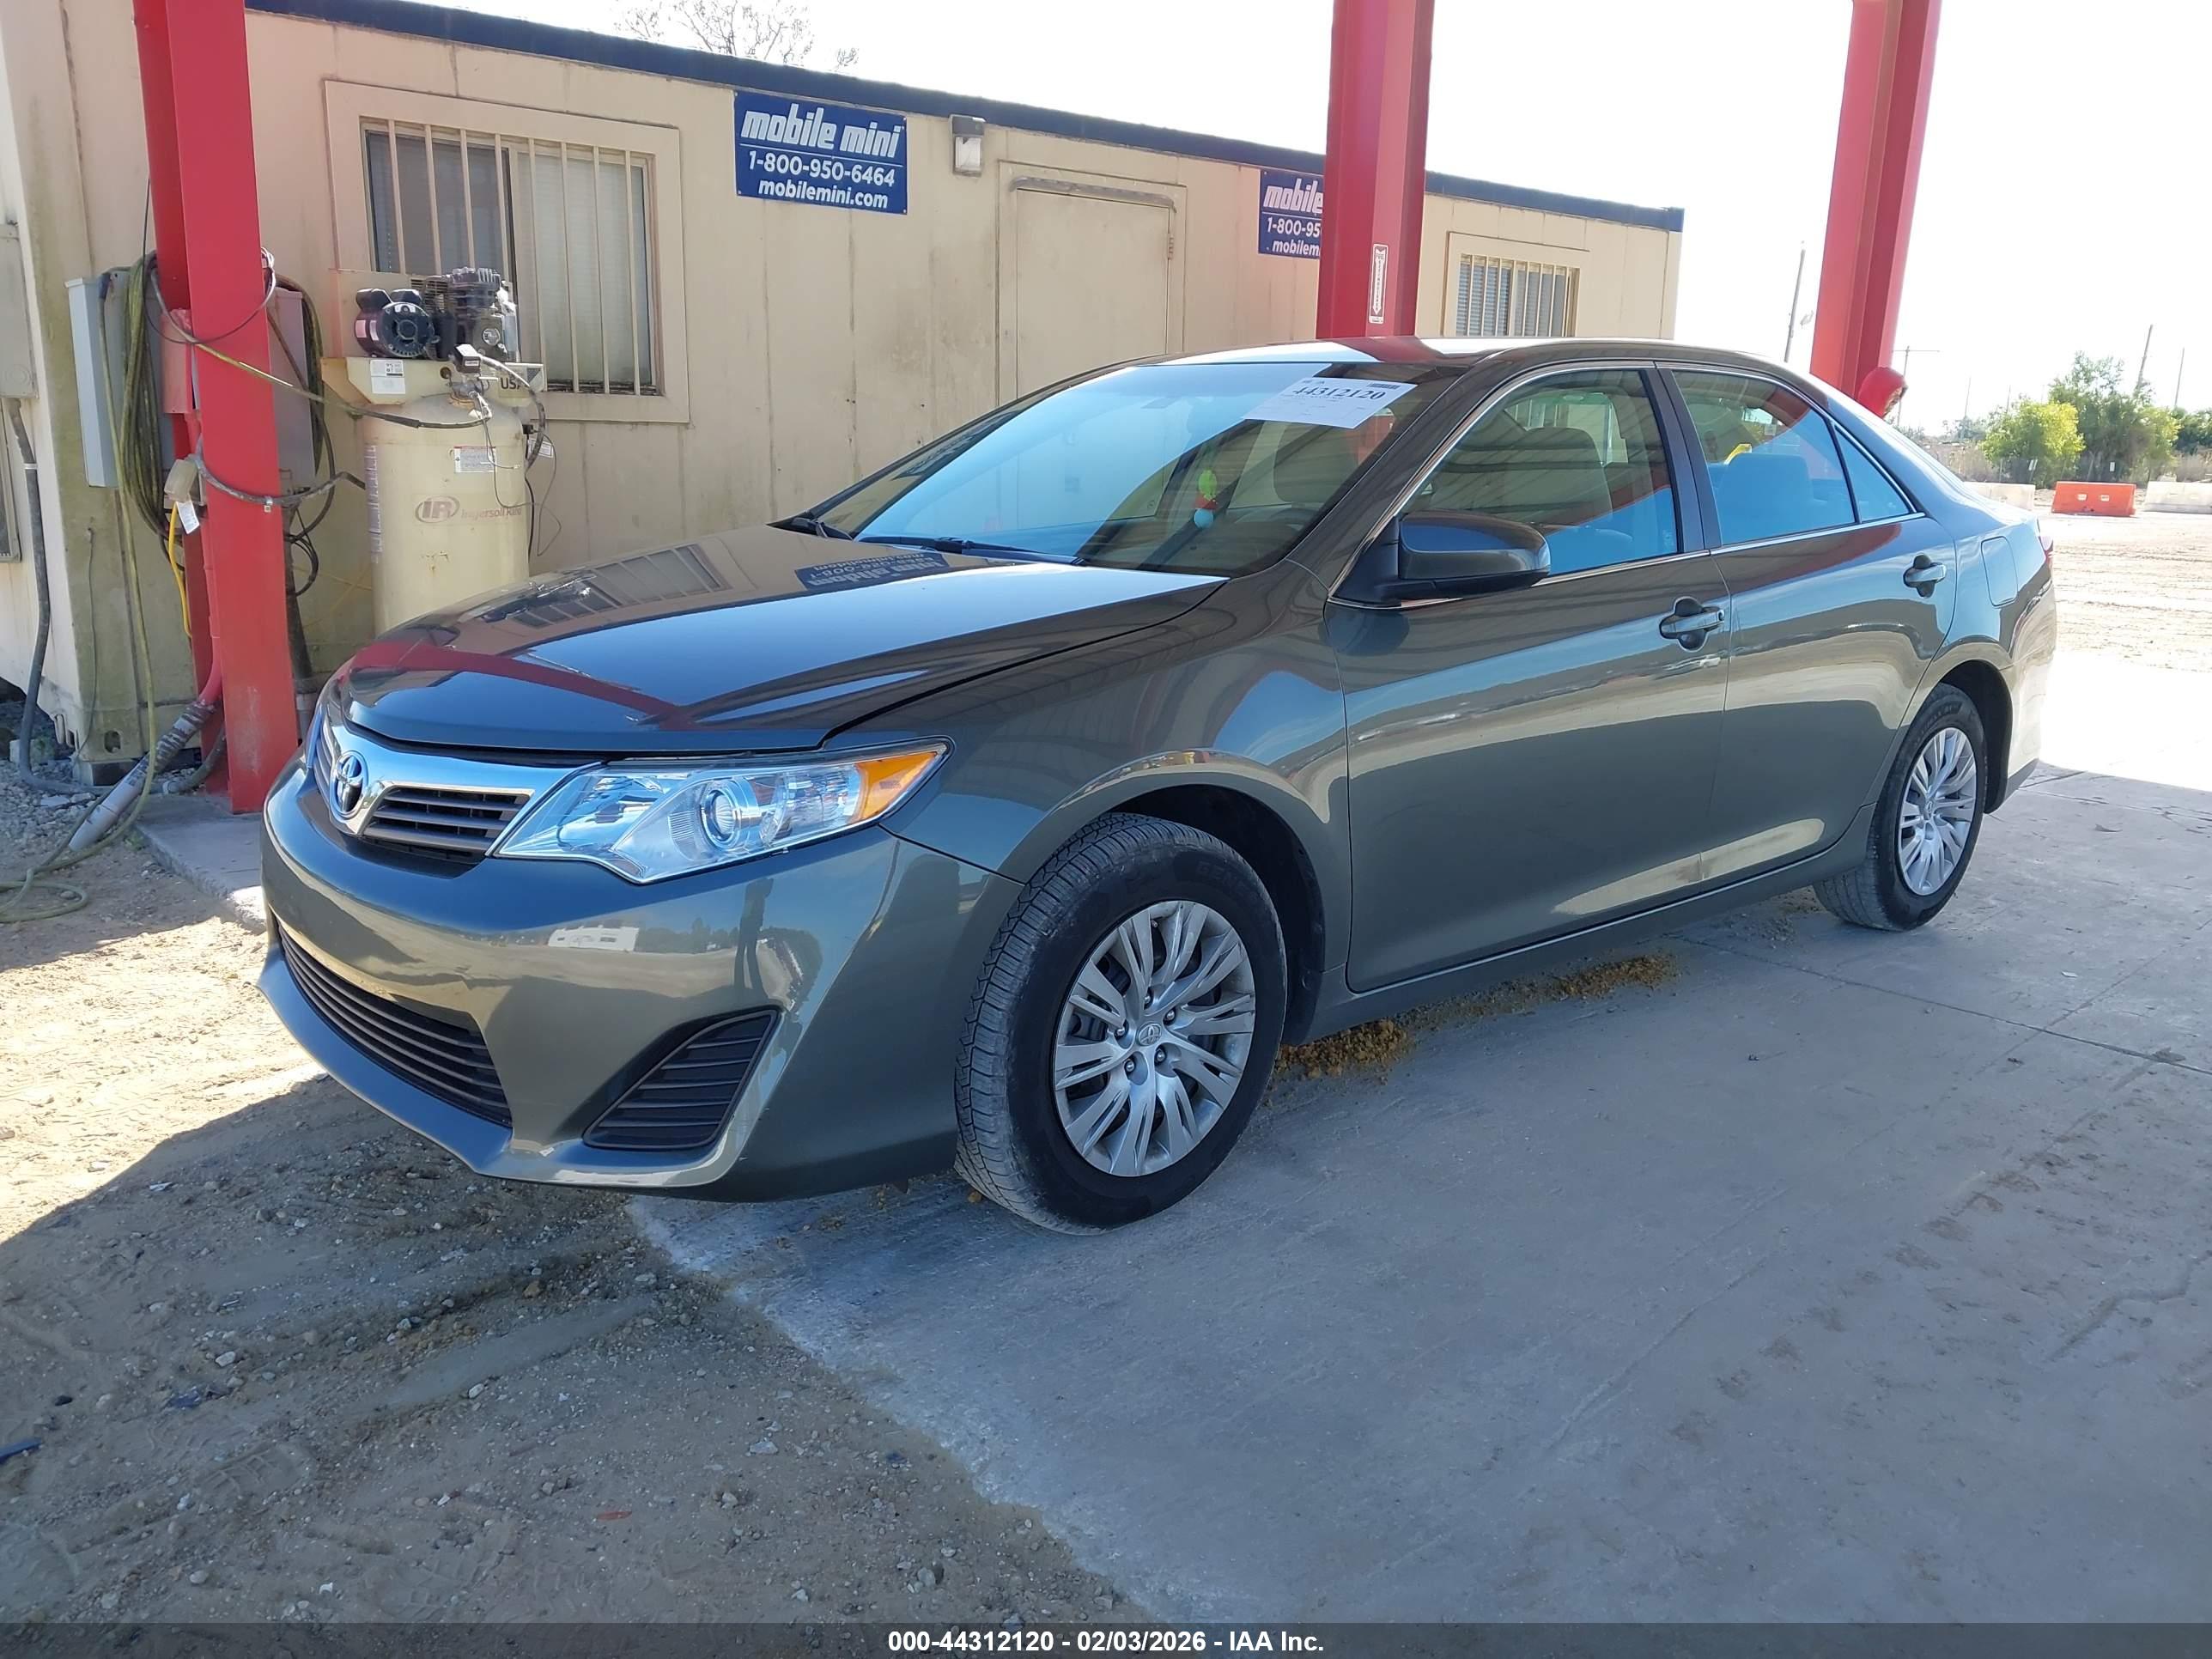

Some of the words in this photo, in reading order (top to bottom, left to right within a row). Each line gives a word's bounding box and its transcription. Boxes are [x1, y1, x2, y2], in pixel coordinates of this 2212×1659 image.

[740, 103, 837, 150] mobile
[840, 122, 901, 158] mini
[749, 150, 895, 187] 1-800-950-6464
[758, 179, 889, 209] mobilemini.com
[1263, 178, 1323, 214] mobile
[1267, 216, 1322, 238] 1-800-95
